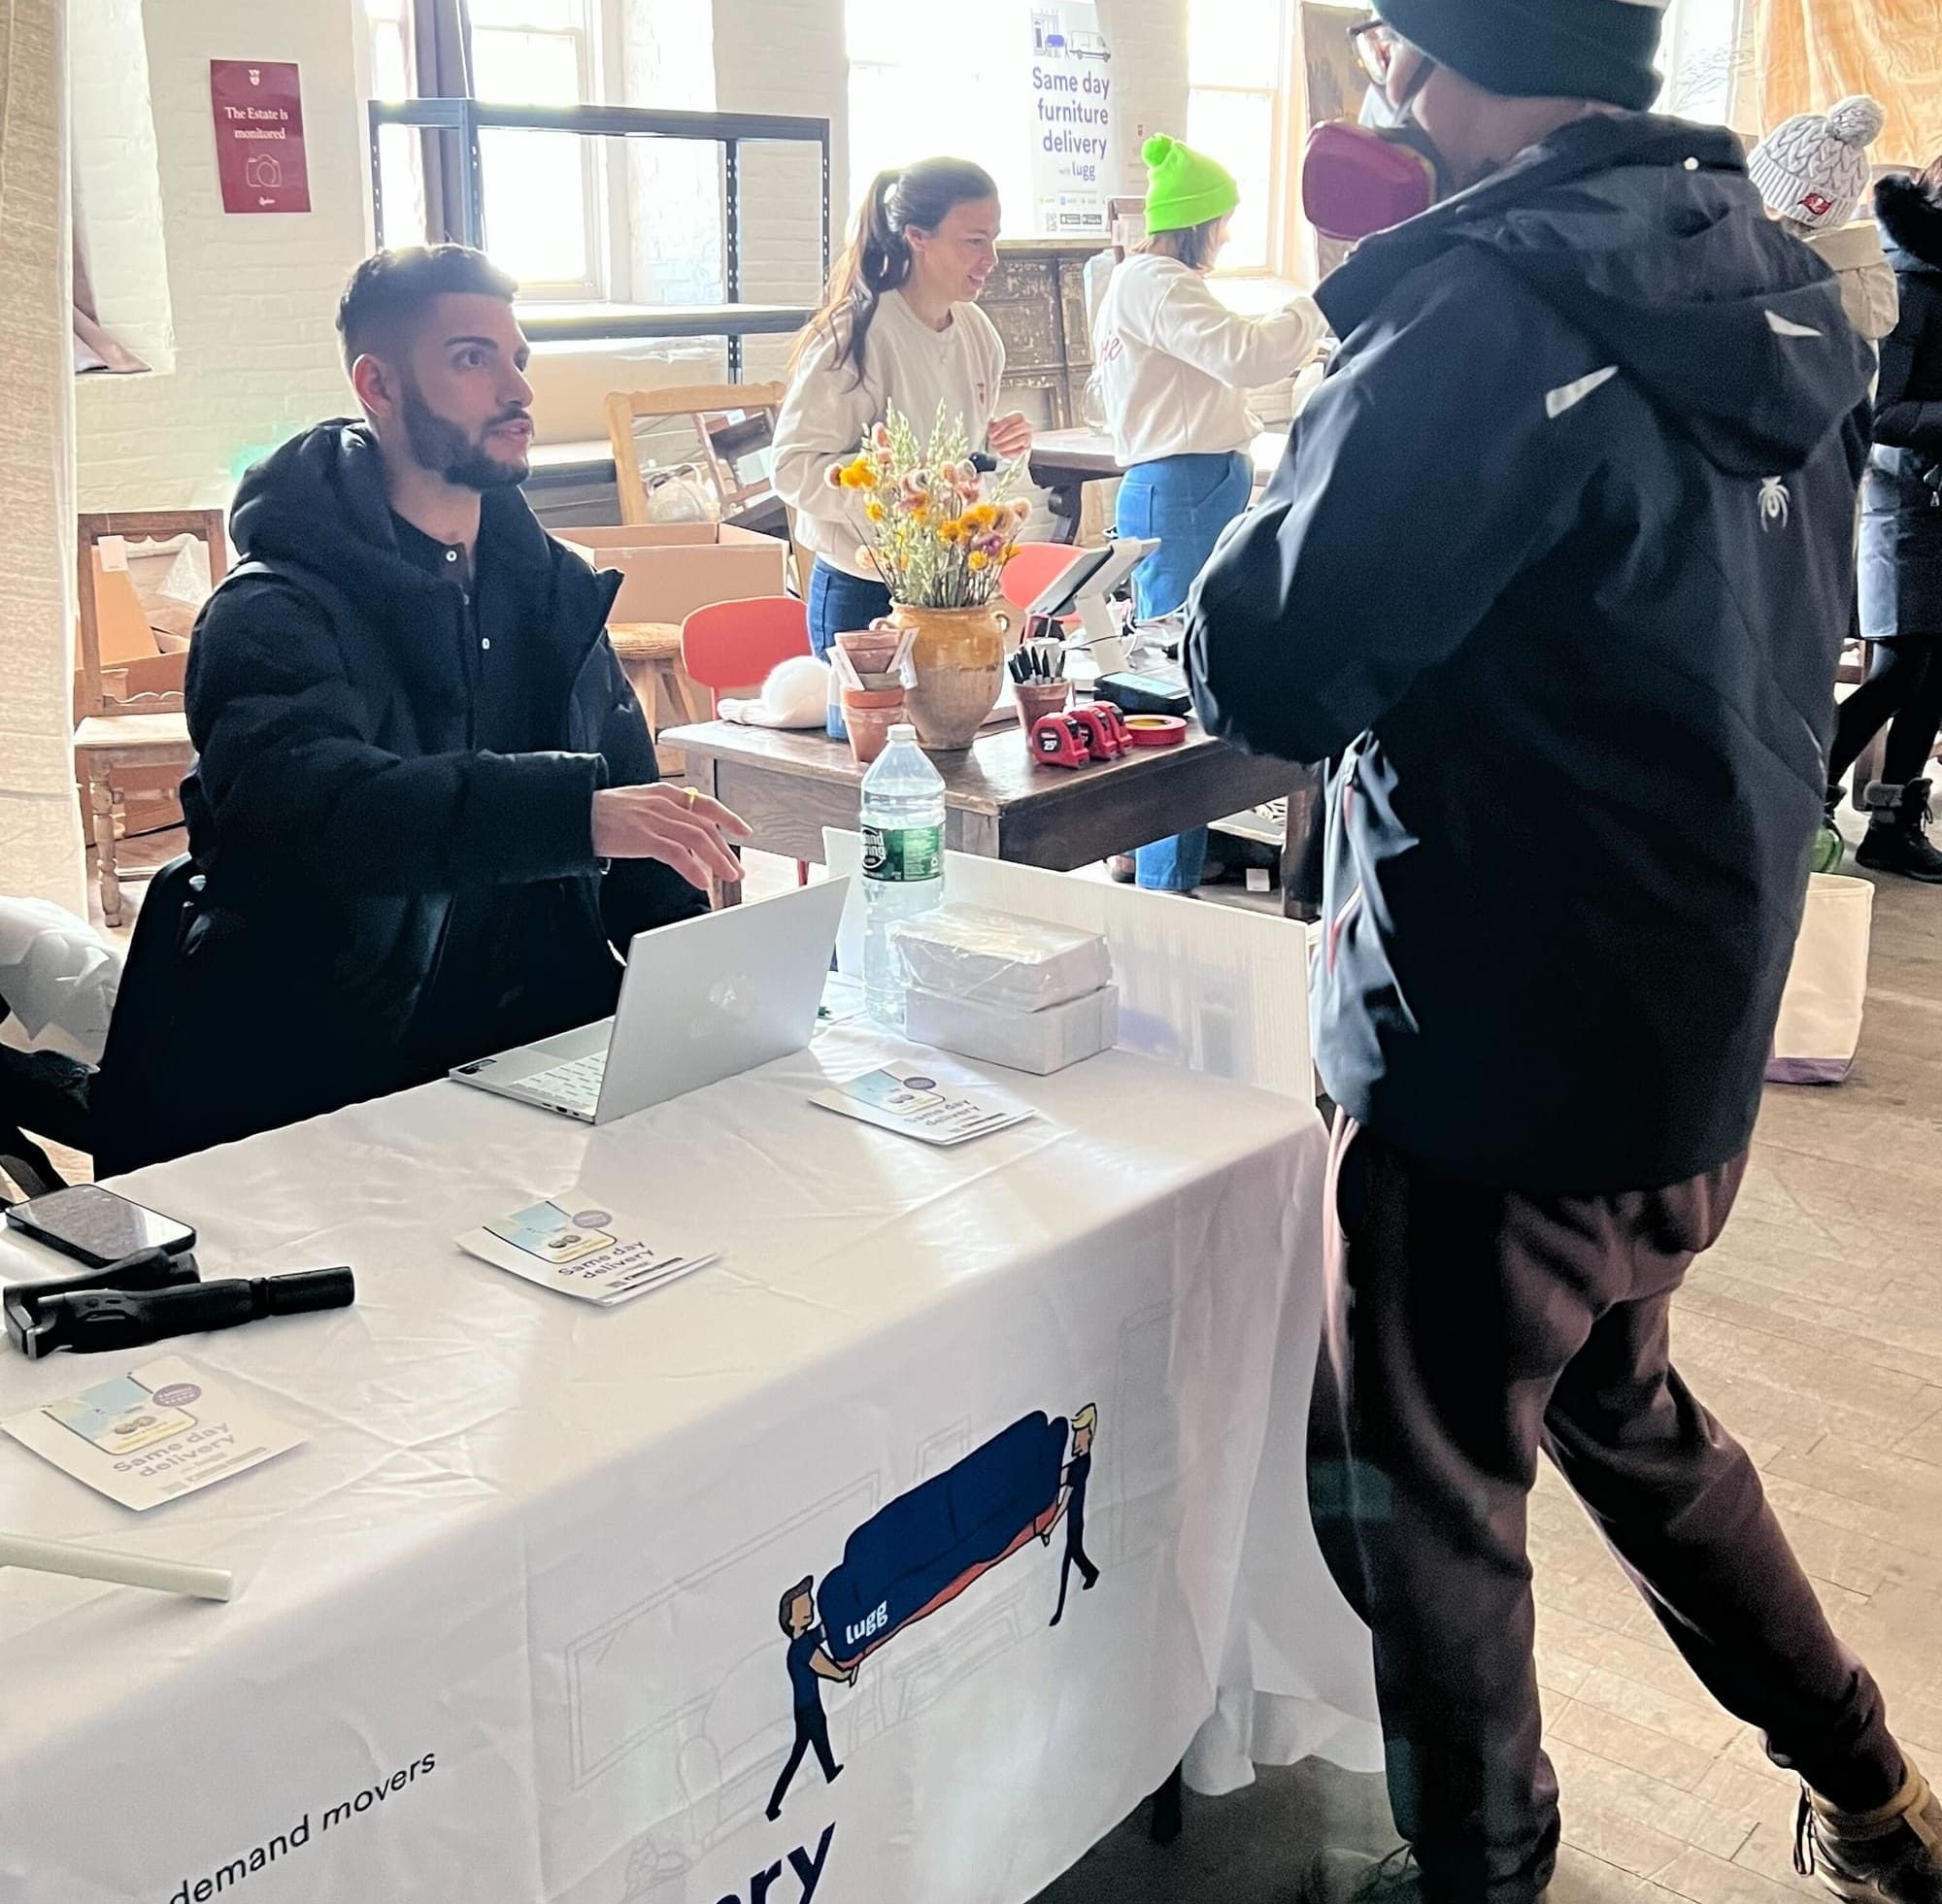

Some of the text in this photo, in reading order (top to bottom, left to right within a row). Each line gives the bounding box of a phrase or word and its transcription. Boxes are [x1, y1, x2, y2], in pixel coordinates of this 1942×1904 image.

[1032, 66, 1110, 100] Same day
[223, 107, 246, 119] The
[248, 107, 278, 120] Estate
[1037, 98, 1109, 125] furniture
[233, 127, 286, 140] monitored
[1042, 129, 1108, 160] delivery
[1072, 161, 1095, 182] lugg
[558, 1255, 611, 1275] Same
[613, 1242, 645, 1255] day
[583, 1250, 653, 1279] delivery
[114, 1443, 183, 1472] Same
[186, 1422, 228, 1443] day
[140, 1434, 235, 1476] delivery
[846, 1600, 888, 1645] lugg
[169, 1752, 437, 1904] demand movers
[715, 1821, 836, 1904] ry
